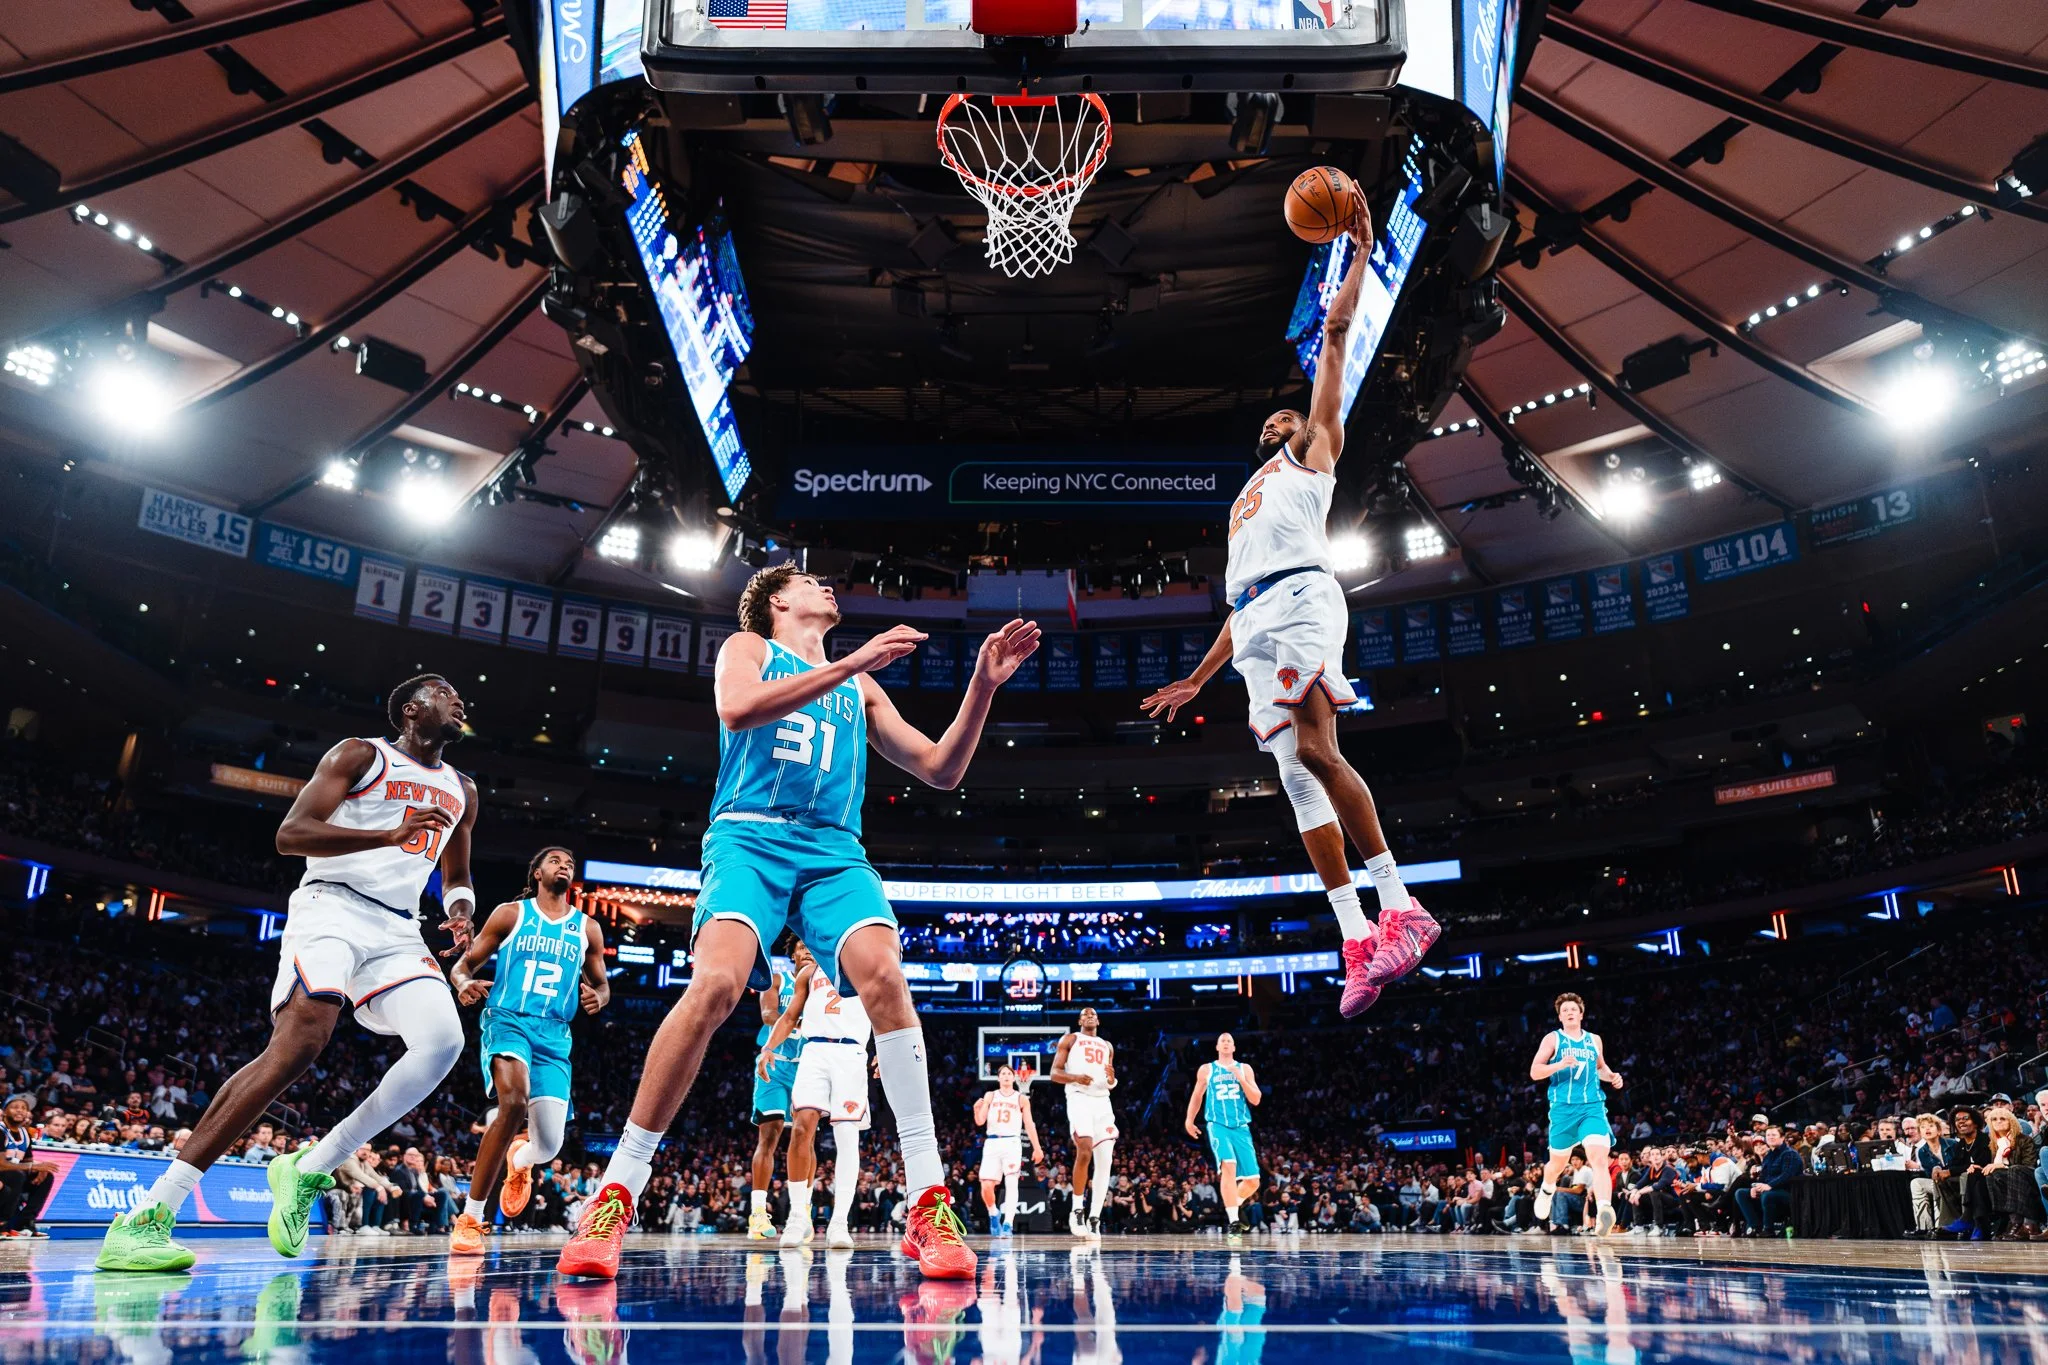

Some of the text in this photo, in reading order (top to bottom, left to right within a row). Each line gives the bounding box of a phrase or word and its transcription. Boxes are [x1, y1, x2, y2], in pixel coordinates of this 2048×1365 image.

[1298, 17, 1320, 30] NBA
[794, 469, 925, 497] Spectrum
[984, 473, 1216, 494] Keeping NYC Connected
[153, 493, 205, 518] HARRY
[1229, 478, 1262, 541] 25
[1812, 504, 1858, 524] PHISH
[1871, 490, 1911, 522] 13
[146, 506, 207, 534] STYLES
[214, 512, 247, 546] 15
[269, 528, 299, 548] BILLY
[1735, 527, 1788, 567] 104
[298, 538, 351, 575] 150
[1703, 542, 1730, 561] BILLY
[1708, 557, 1733, 574] JOEL
[371, 579, 386, 606] 1
[424, 591, 445, 618] 2
[473, 601, 492, 628] 3
[522, 609, 540, 636] 7
[570, 618, 588, 645] 9
[617, 626, 635, 651] 9
[657, 631, 682, 659] 11
[705, 639, 717, 664] 1
[772, 711, 837, 773] 31
[385, 781, 427, 802] NEW
[428, 786, 462, 821] YORK
[891, 884, 1125, 900] SUPERIOR LIGHT BEER
[1191, 879, 1266, 898] Michelob
[516, 935, 578, 962] HORNETS
[522, 960, 563, 997] 12
[1010, 977, 1037, 998] 20
[825, 990, 842, 1015] 2
[1085, 1047, 1104, 1064] 50
[1561, 1048, 1595, 1061] HORNETS
[1574, 1061, 1587, 1080] 7
[1215, 1084, 1240, 1100] 22
[997, 1110, 1011, 1123] 13
[1420, 1134, 1452, 1146] ULTRA
[85, 1168, 137, 1182] experience
[88, 1183, 126, 1209] abu
